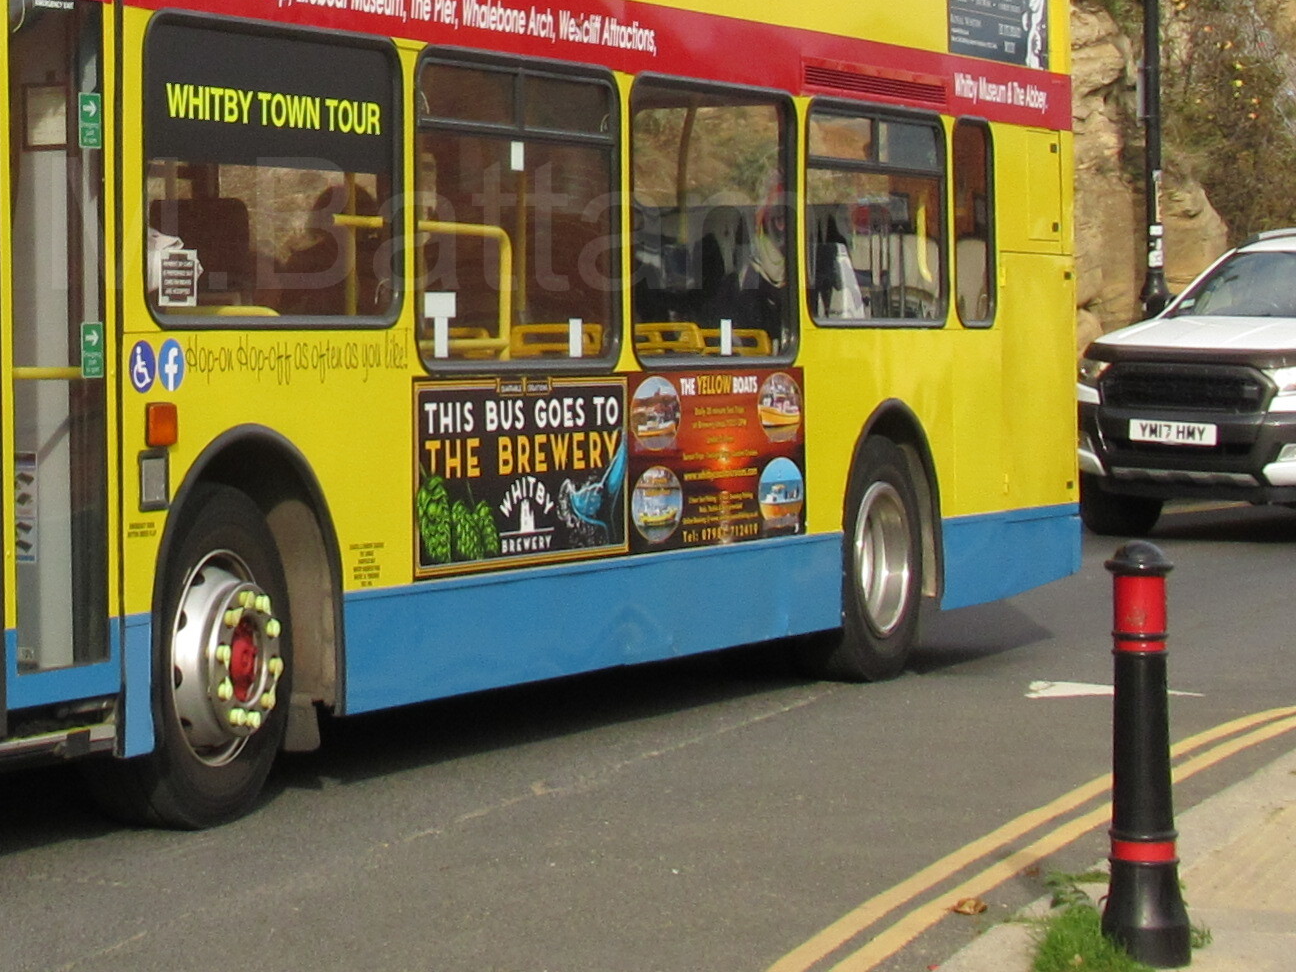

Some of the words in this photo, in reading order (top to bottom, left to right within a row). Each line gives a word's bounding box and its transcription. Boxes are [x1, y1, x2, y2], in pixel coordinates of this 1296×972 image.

[527, 5, 556, 44] Arch,
[601, 15, 657, 57] Attractions,
[165, 82, 253, 125] WHITBY
[257, 91, 321, 131] TOWN
[325, 98, 382, 136] TOUR
[1012, 81, 1025, 106] The
[294, 342, 309, 371] as
[344, 342, 359, 371] as
[361, 343, 381, 384] you
[680, 377, 696, 396] THE
[696, 374, 733, 395] YELLOW
[732, 375, 758, 394] BOATS
[424, 402, 475, 435] THIS
[485, 399, 525, 432] BUS
[534, 396, 586, 428] GOES
[592, 395, 619, 426] TO
[1139, 422, 1172, 439] YM17
[425, 437, 481, 479] THE
[497, 430, 620, 476] BREWERY
[499, 475, 555, 518] WHITBY
[501, 534, 552, 554] BREWERY
[683, 530, 699, 543] Tel:
